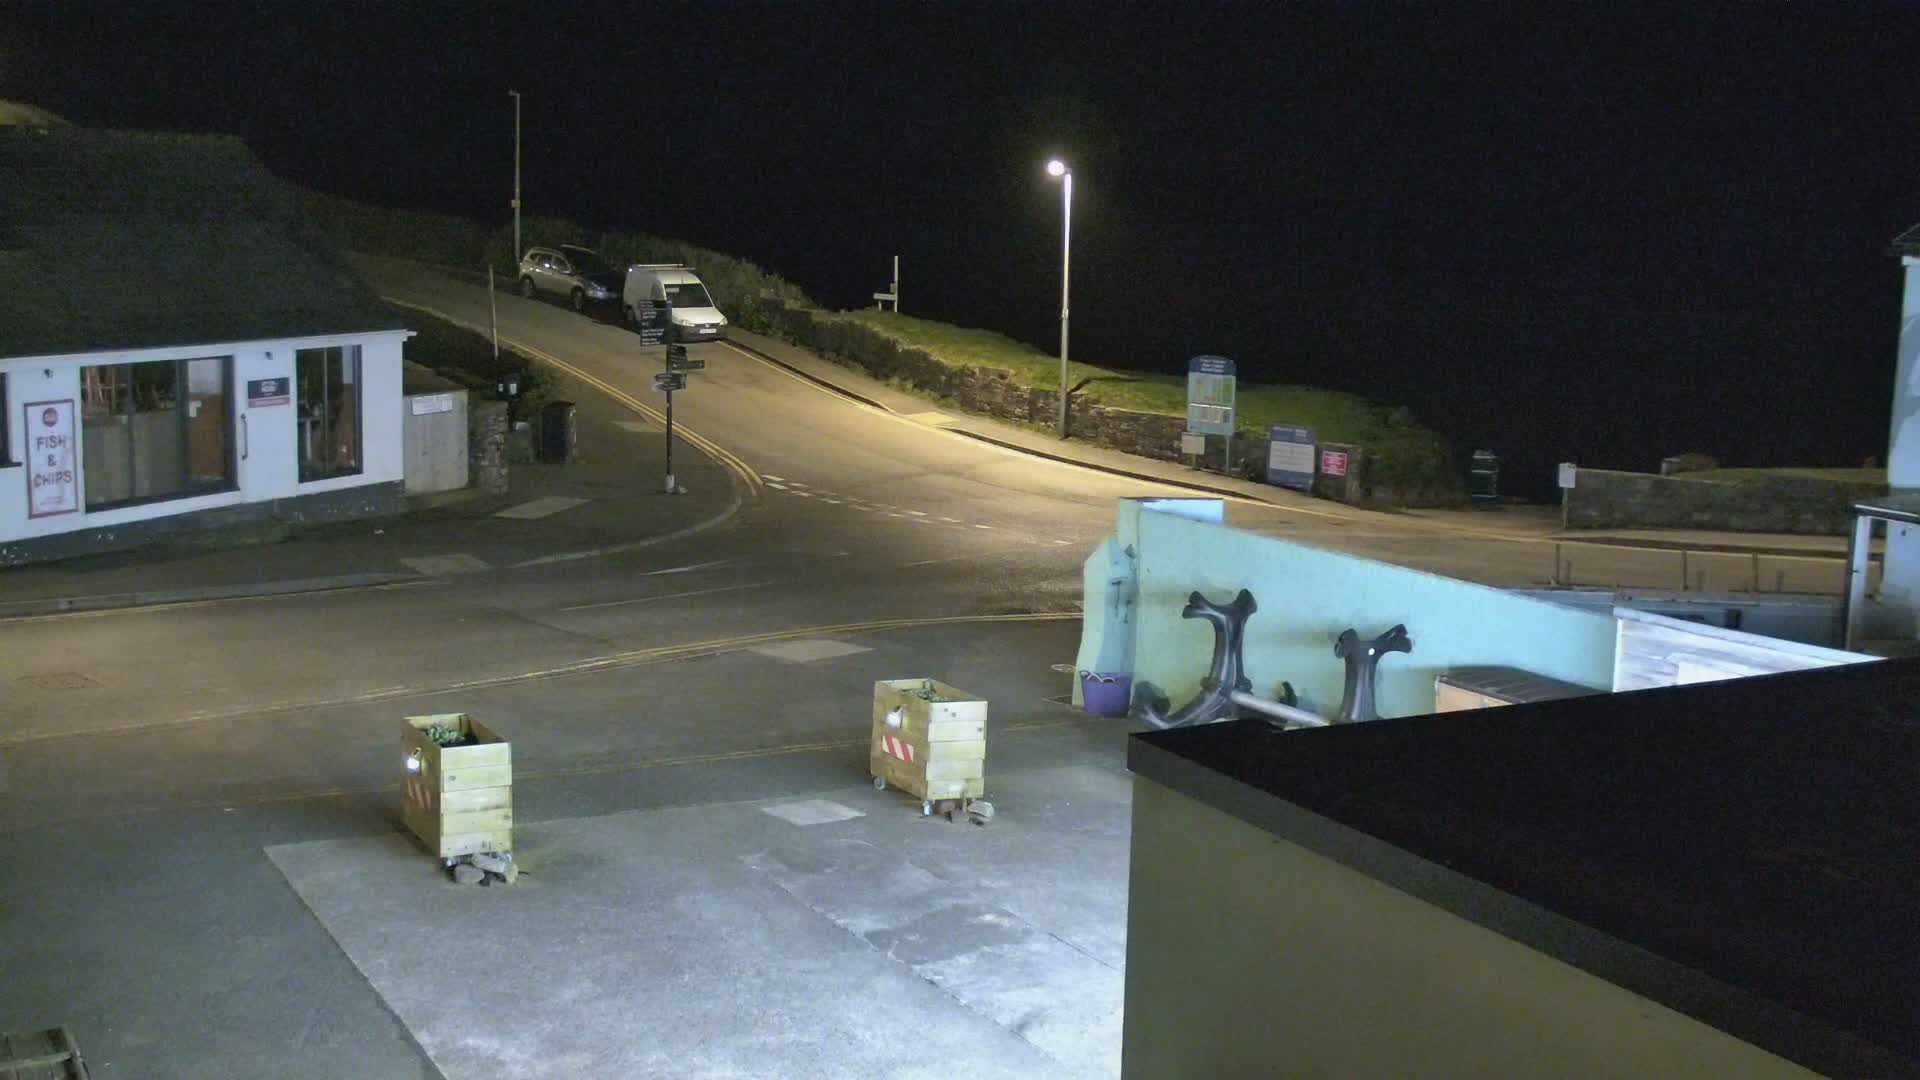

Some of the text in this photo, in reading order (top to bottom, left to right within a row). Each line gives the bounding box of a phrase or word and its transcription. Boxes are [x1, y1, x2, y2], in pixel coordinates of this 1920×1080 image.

[36, 435, 66, 450] FISH
[47, 454, 56, 467] &
[34, 470, 73, 488] CHIPS
